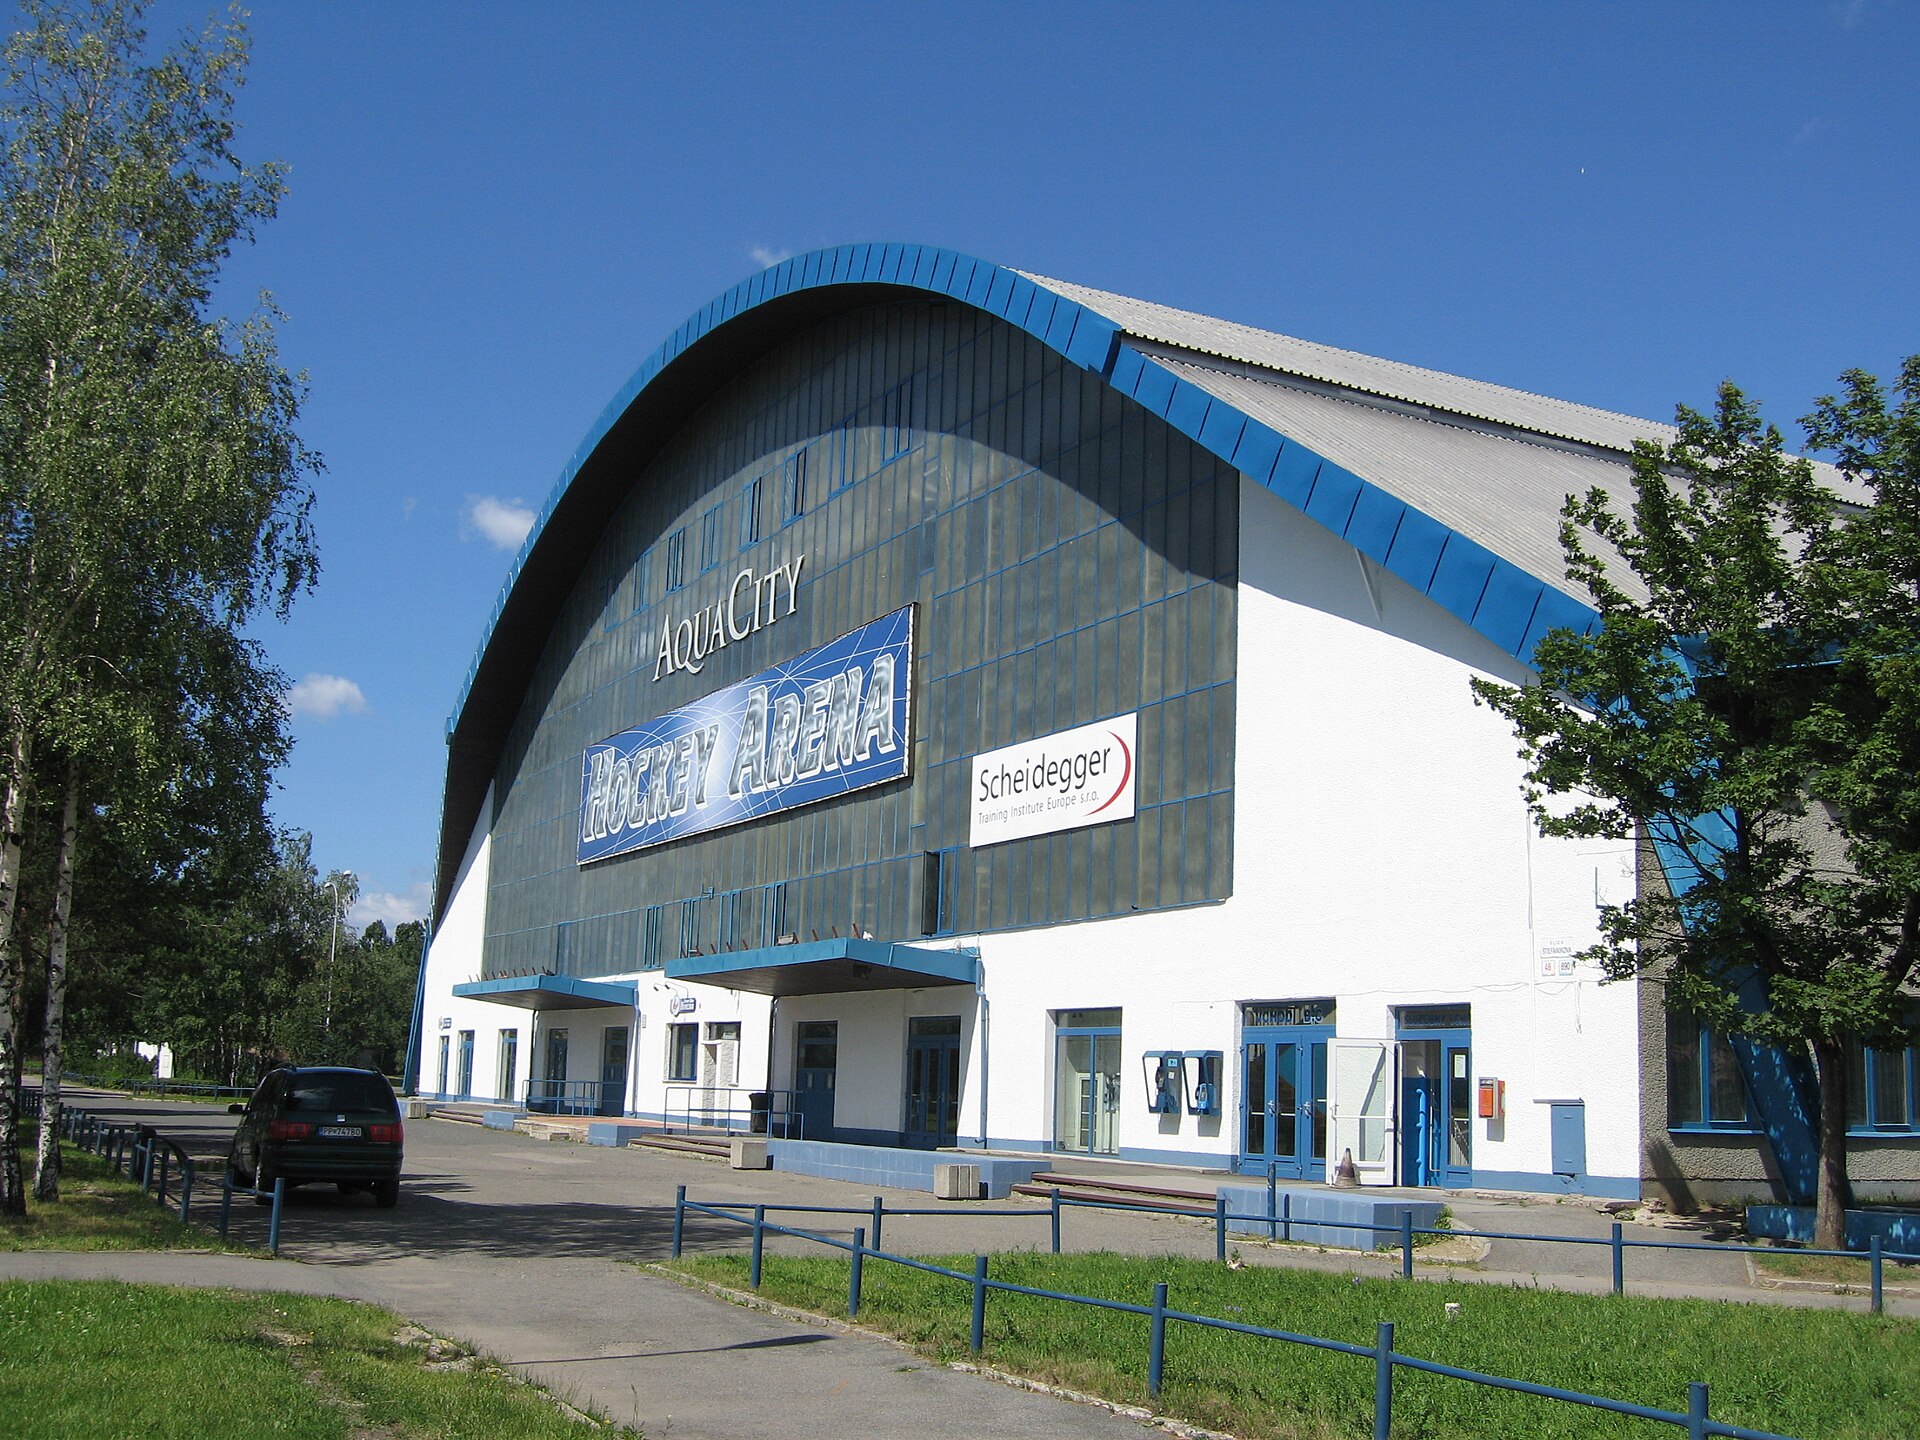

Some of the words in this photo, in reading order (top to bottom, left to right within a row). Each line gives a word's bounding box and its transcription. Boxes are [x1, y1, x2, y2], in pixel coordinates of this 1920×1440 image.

[582, 723, 720, 843] HOCKEY
[727, 653, 896, 800] ARENA
[979, 747, 1111, 801] Scheidegger
[978, 808, 1008, 824] Training
[1011, 802, 1044, 817] Institute
[1047, 794, 1077, 809] Europe
[1080, 790, 1099, 803] s.r.o.
